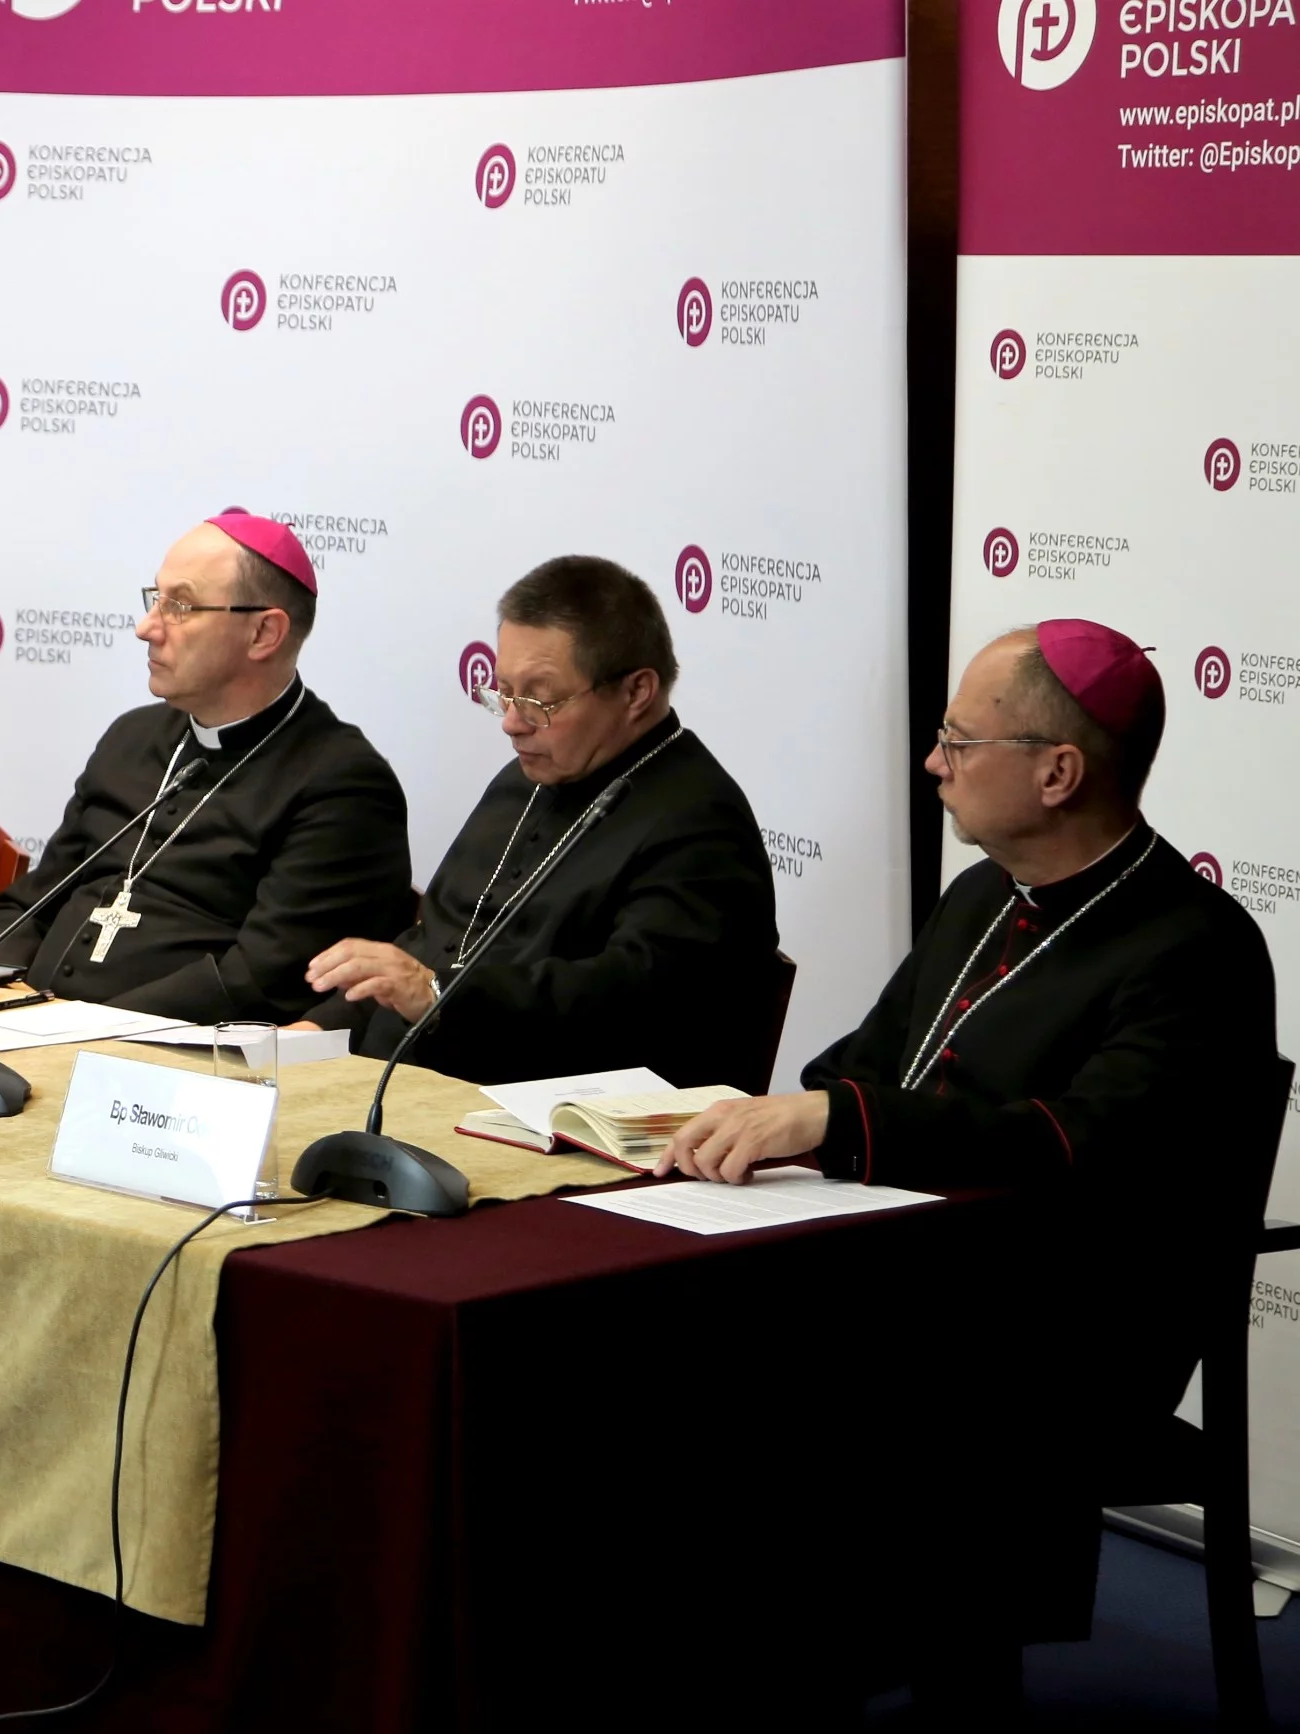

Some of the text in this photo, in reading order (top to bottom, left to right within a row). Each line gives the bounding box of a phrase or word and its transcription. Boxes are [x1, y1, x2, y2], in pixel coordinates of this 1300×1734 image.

[1120, 38, 1241, 79] POLSKI
[1119, 95, 1300, 130] www.episkopat.pl
[28, 145, 152, 163] KONFERENCJA
[527, 144, 625, 163] KONFERENCJA
[1118, 142, 1194, 169] Twitter:
[27, 164, 128, 183] EPISKOPATU
[525, 167, 606, 185] EPISKOPATU
[27, 183, 84, 200] POLSKI
[524, 188, 571, 206] POLSKI
[279, 274, 397, 292] KONFERENCJA
[721, 280, 818, 299] KONFERENCJA
[278, 294, 374, 312] EPISKOPATU
[278, 313, 332, 331] POLSKI
[720, 304, 799, 323] EPISKOPATU
[721, 327, 766, 345] POLSKI
[1036, 332, 1139, 348] KONFERENCJA
[1035, 348, 1120, 364] EPISKOPATU
[1035, 365, 1083, 380] POLSKI
[21, 378, 141, 398] KONFERENCJA
[20, 398, 118, 417] EPISKOPATU
[512, 400, 615, 423] KONFERENCJA
[20, 416, 75, 433] POLSKI
[511, 422, 596, 443] EPISKOPATU
[511, 442, 560, 461] POLSKI
[1251, 442, 1300, 458] KONFE
[1249, 459, 1300, 476] EPISKO
[1249, 477, 1296, 493] POLSKI
[1029, 532, 1130, 552] KONFERENCJA
[721, 552, 821, 582] KONFERENCJA
[1028, 549, 1111, 567] EPISKOPATU
[1028, 565, 1076, 581] POLSKI
[720, 578, 802, 603] EPISKOPATU
[721, 598, 767, 620] POLSKI
[16, 608, 135, 630] KONFERENCJA
[14, 629, 114, 648] EPISKOPATU
[14, 647, 71, 664] POLSKI
[1239, 686, 1285, 705] POLSKI
[110, 1099, 128, 1125] Bp
[129, 1103, 186, 1132] Sławomir
[132, 1143, 153, 1158] Biskup
[1252, 1281, 1300, 1305] ERENC
